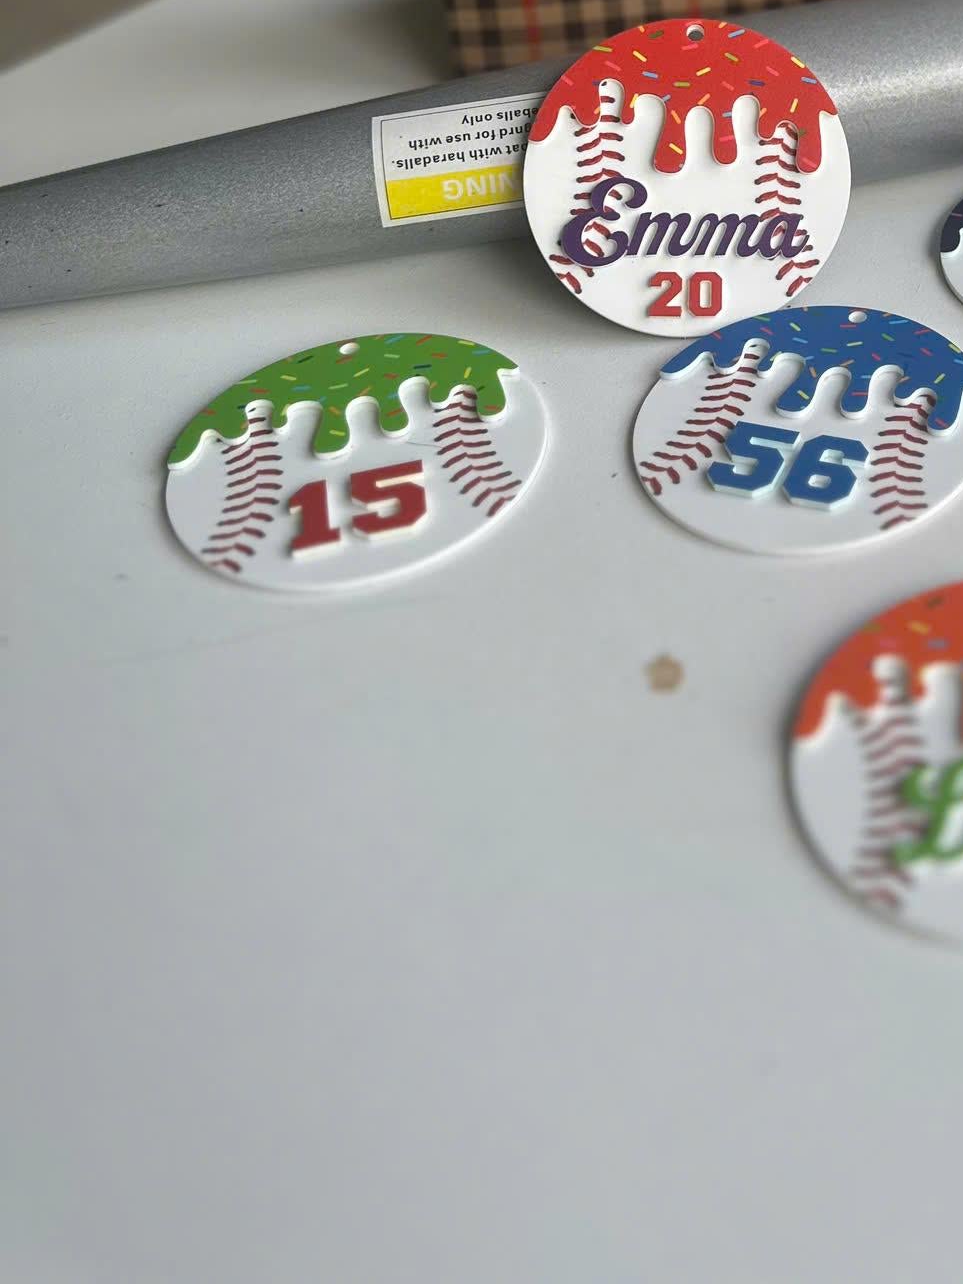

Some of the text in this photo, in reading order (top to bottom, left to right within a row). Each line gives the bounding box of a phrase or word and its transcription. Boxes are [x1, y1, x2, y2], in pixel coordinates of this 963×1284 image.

[461, 114, 493, 125] only
[446, 133, 471, 144] use
[475, 129, 496, 141] for
[408, 137, 442, 151] with
[469, 147, 502, 162] with
[561, 176, 809, 267] Emma
[648, 271, 723, 318] 20
[706, 420, 870, 509] 56
[288, 460, 428, 554] 15
